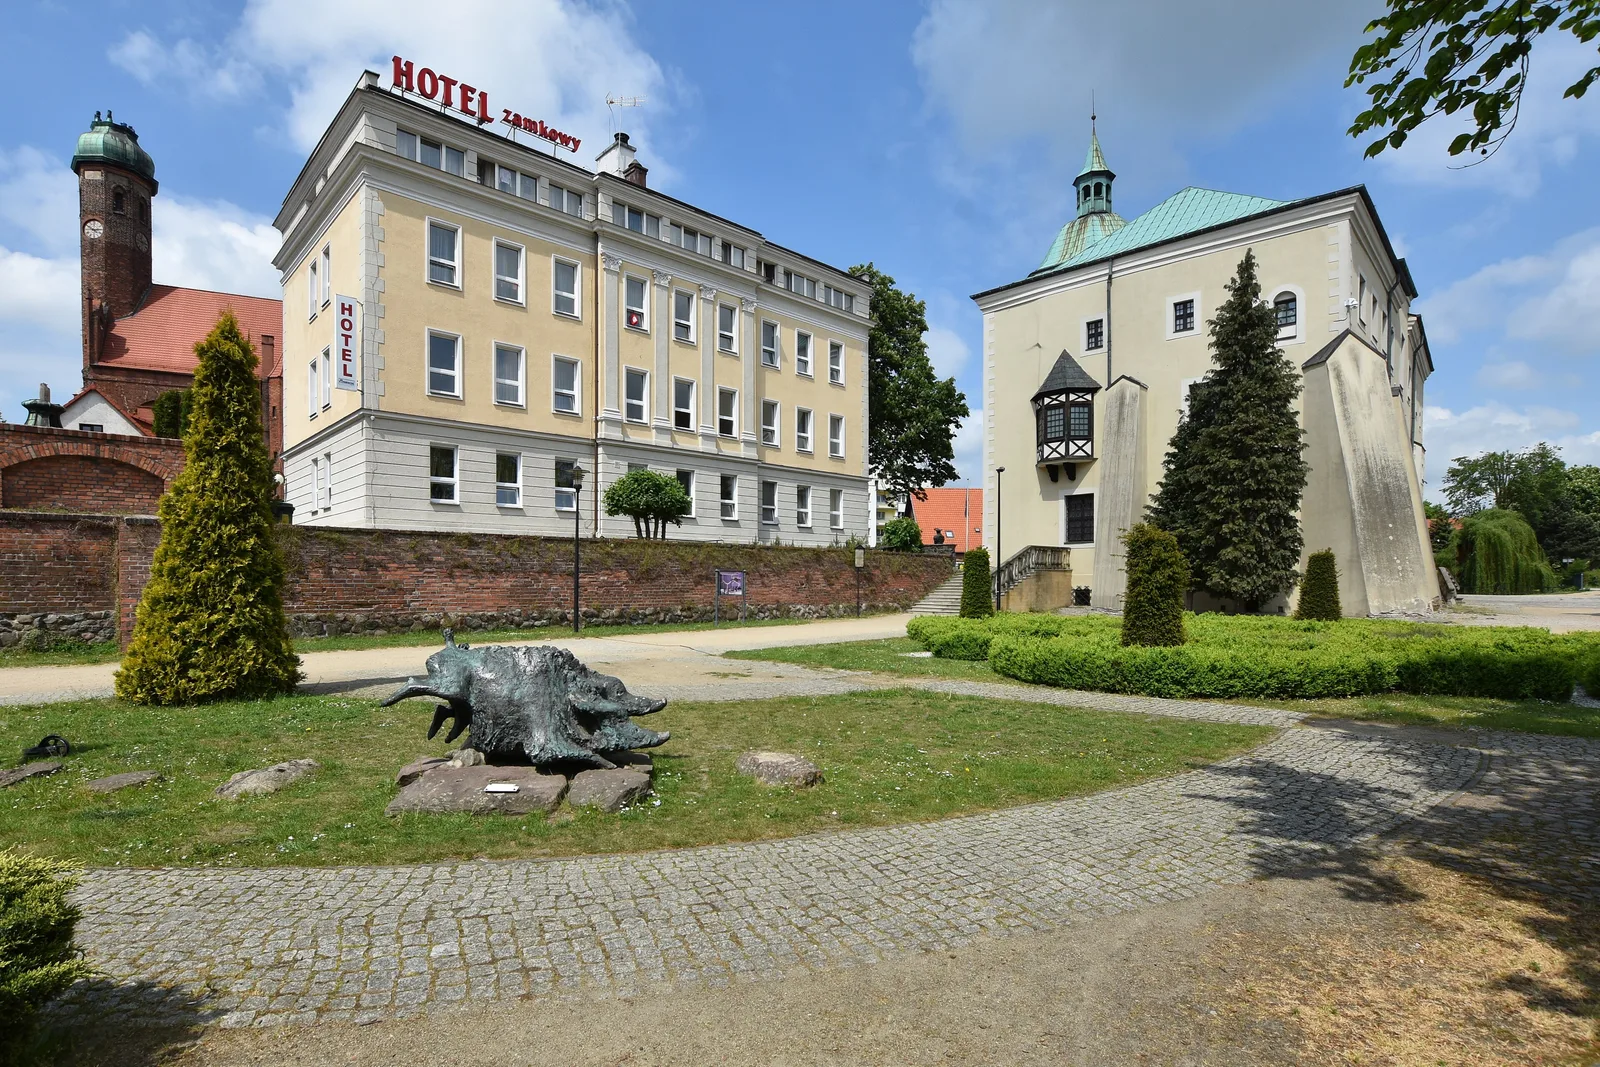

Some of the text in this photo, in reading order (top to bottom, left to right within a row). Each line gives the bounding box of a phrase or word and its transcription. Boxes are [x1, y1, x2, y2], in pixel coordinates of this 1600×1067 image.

[392, 56, 581, 153] HOTEL zamkowy
[340, 302, 353, 378] HOTEL
